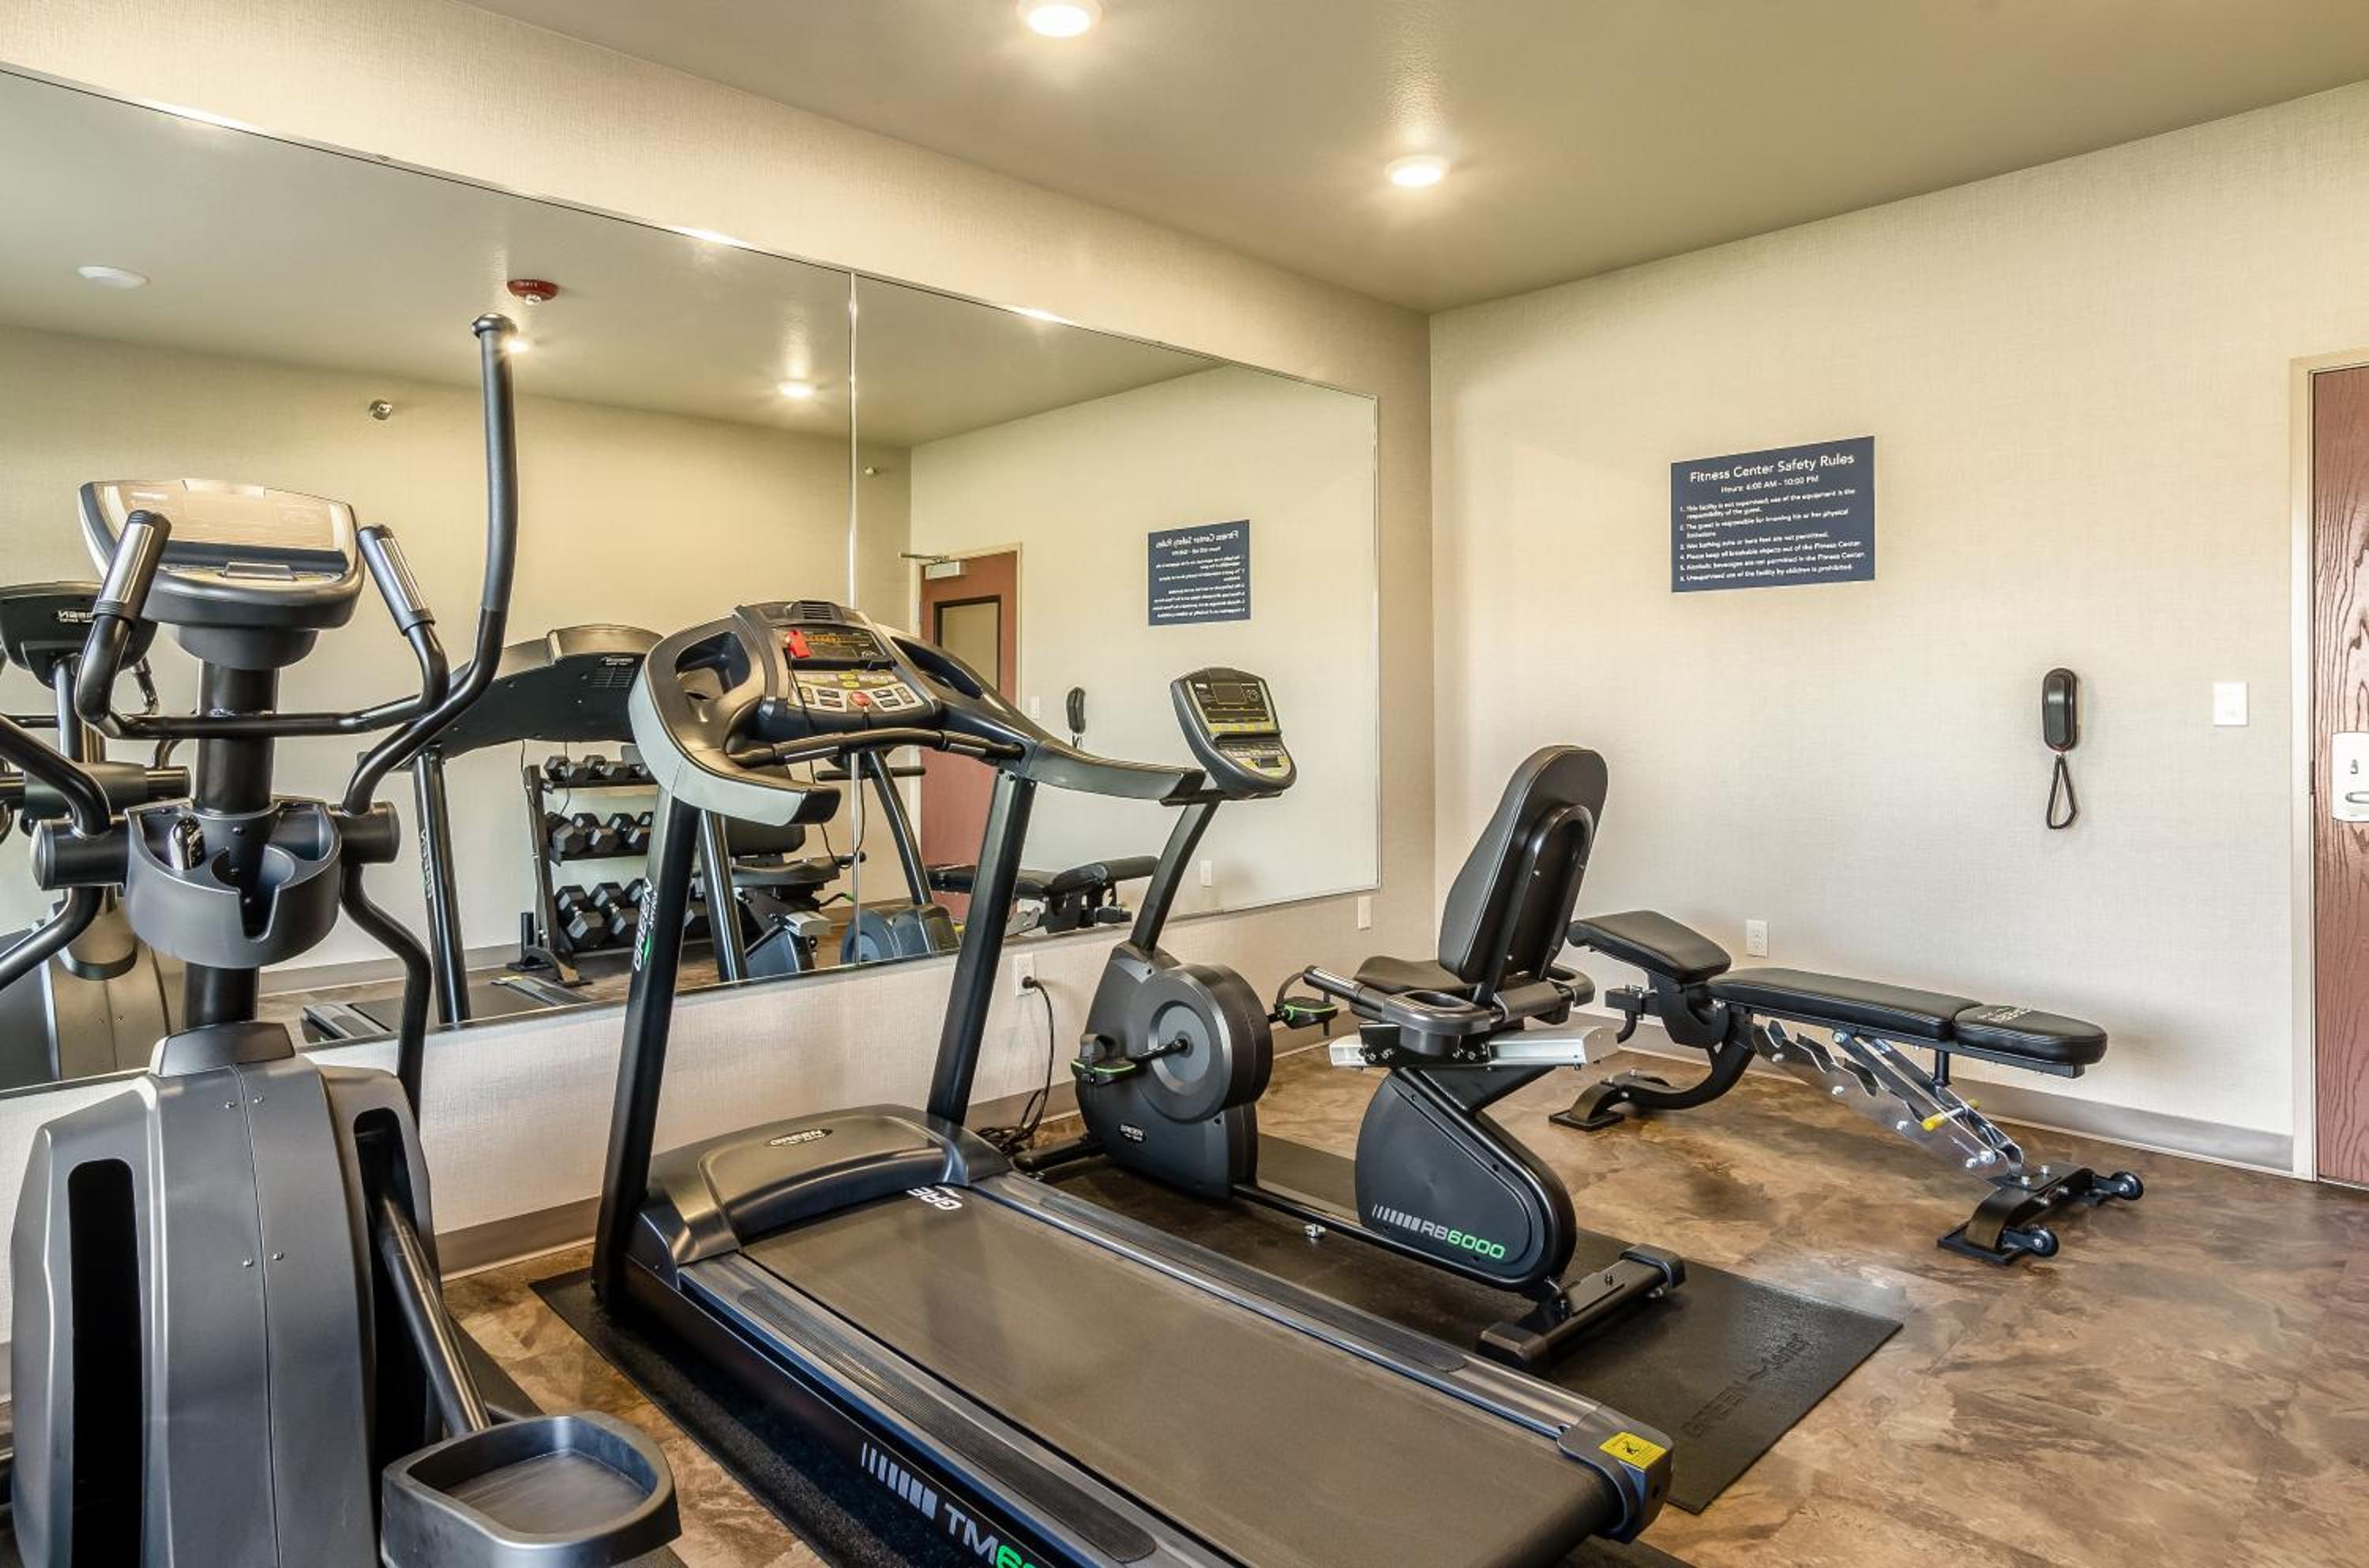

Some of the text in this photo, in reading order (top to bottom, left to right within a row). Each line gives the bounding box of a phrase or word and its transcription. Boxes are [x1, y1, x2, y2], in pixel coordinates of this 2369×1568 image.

[1691, 452, 1854, 482] Fitness Center Safety Rules
[1763, 479, 1777, 488] AM
[1421, 1220, 1505, 1259] RB6000
